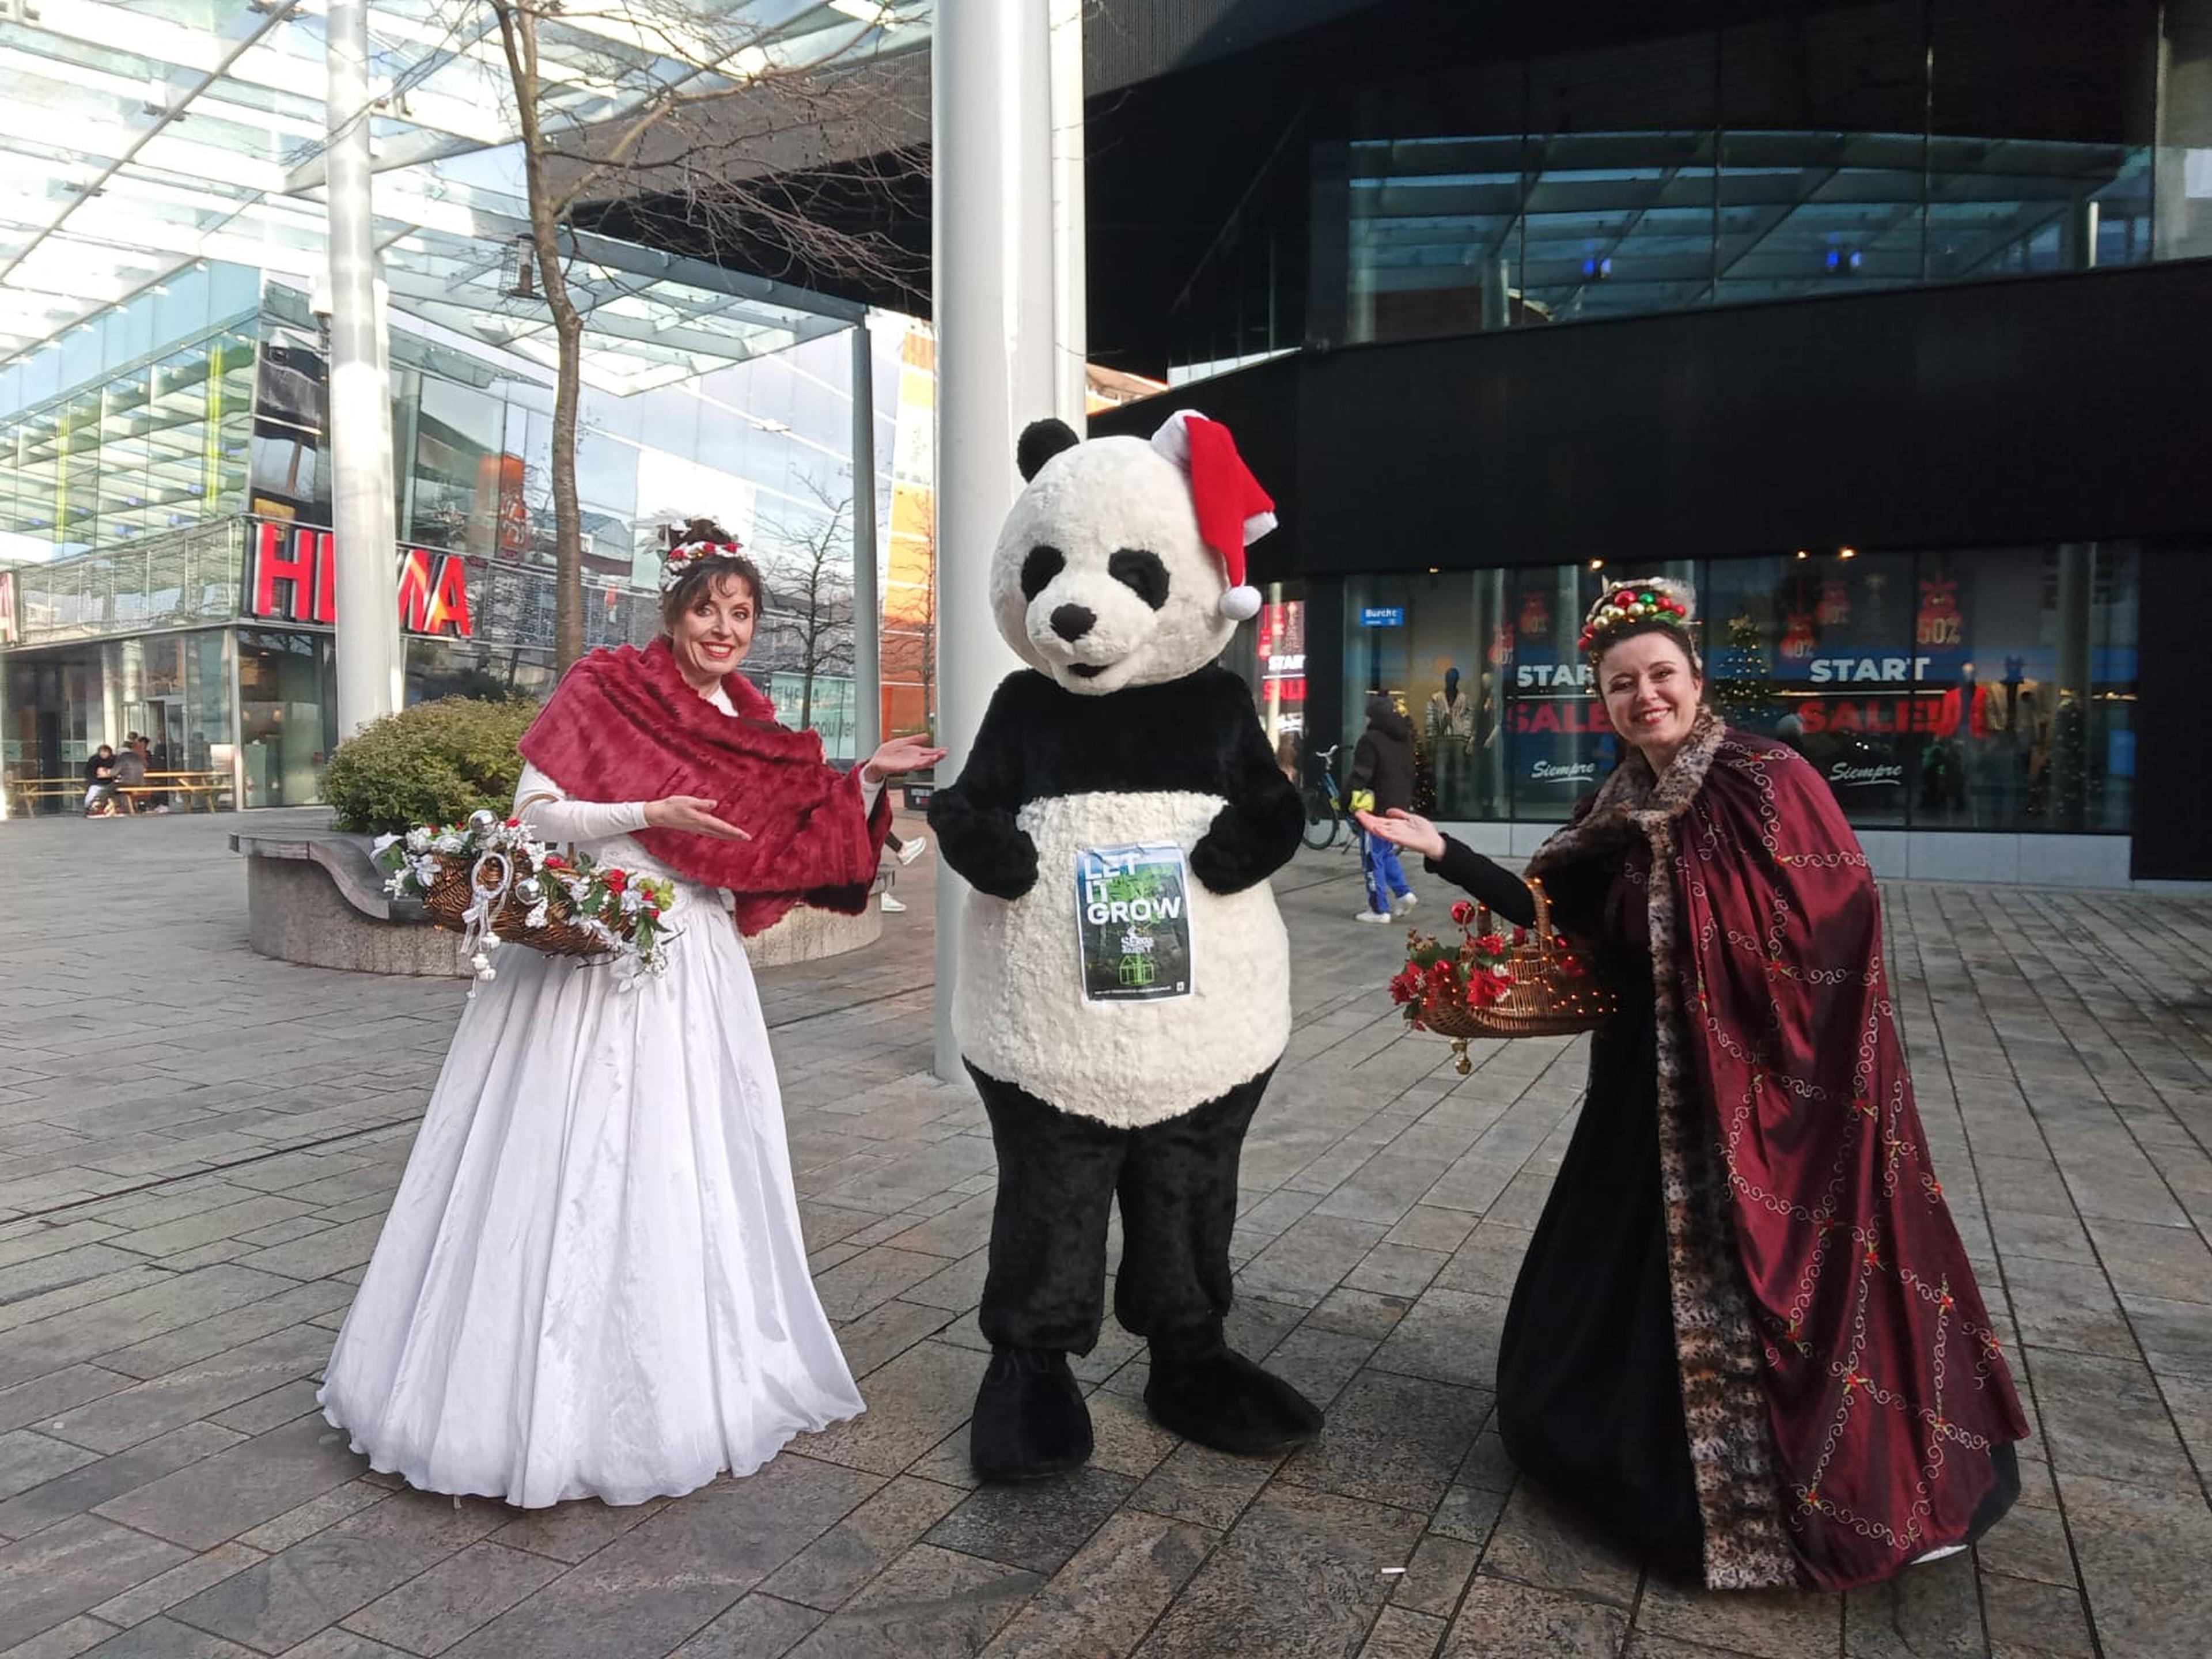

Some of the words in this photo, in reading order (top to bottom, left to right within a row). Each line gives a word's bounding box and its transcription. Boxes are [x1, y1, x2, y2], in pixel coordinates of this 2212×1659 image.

[1517, 664, 1594, 687] STAR
[1810, 657, 1930, 683] START
[1531, 760, 1595, 778] Siempre
[1828, 762, 1903, 782] Siempre
[1084, 853, 1140, 880] LET
[1087, 896, 1181, 925] GROW
